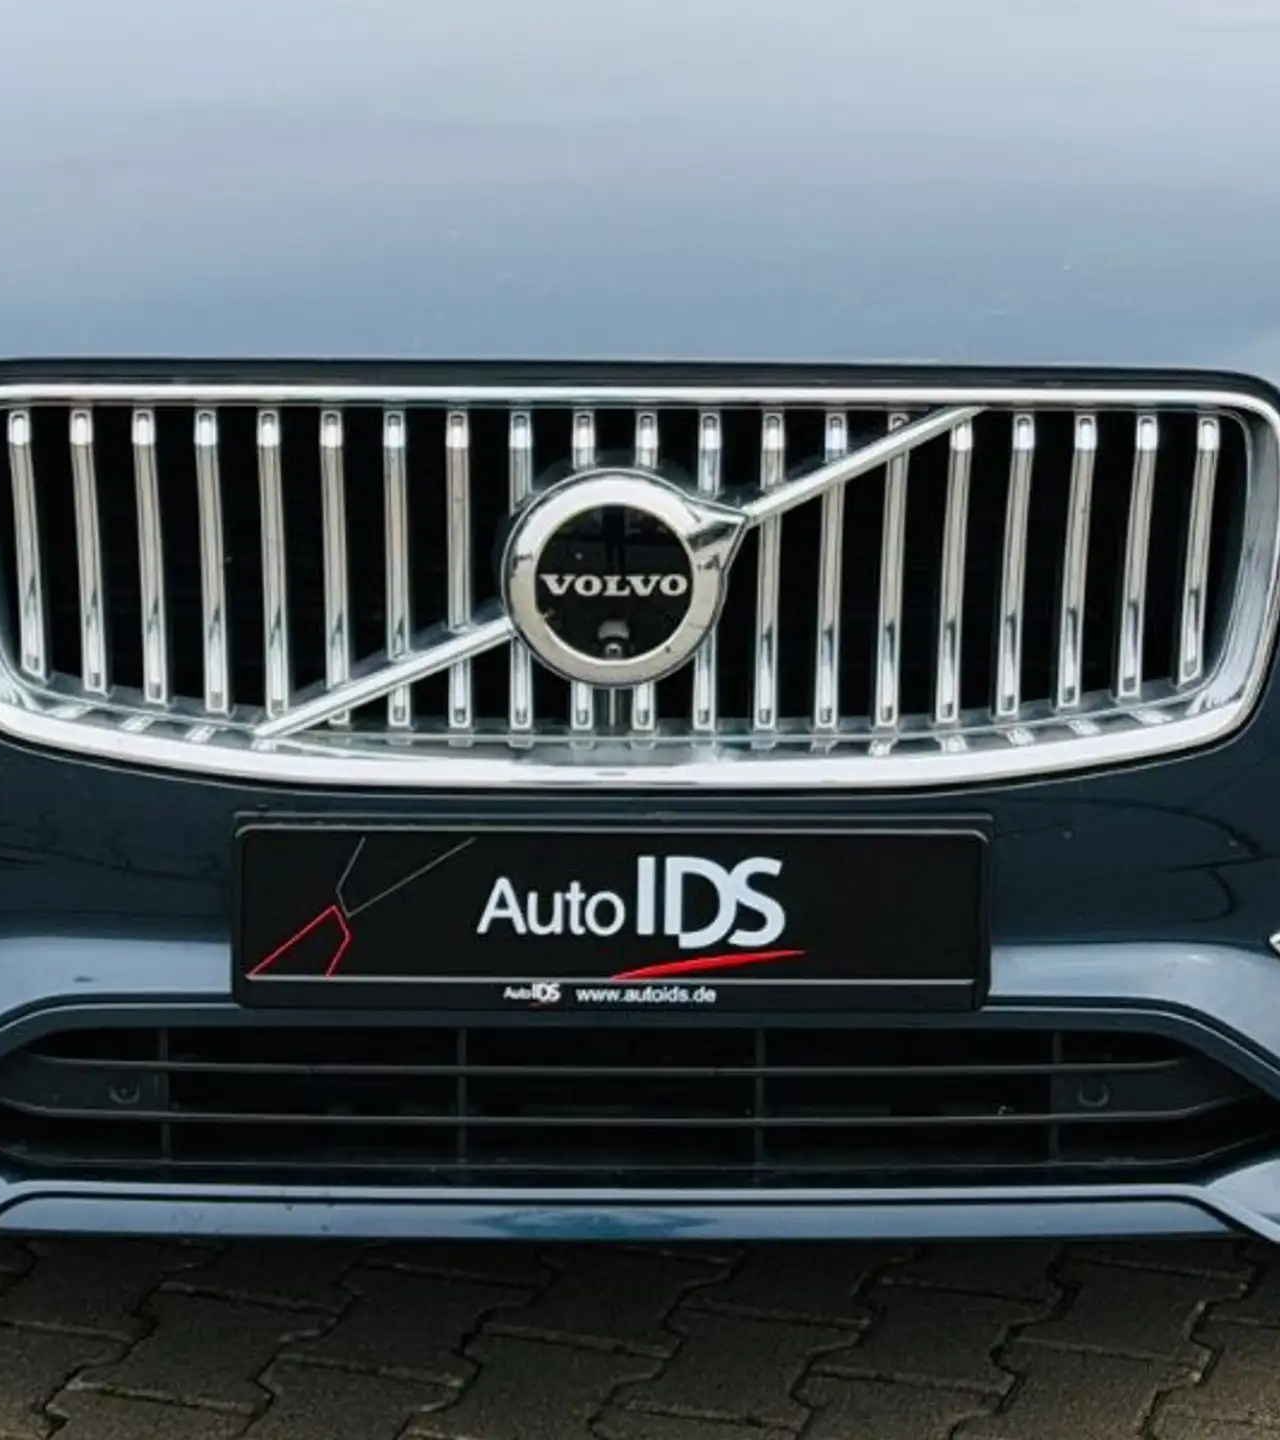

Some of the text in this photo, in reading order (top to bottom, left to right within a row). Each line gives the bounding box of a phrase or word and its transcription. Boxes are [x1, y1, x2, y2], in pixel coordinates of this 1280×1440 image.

[539, 573, 688, 597] VOLVO
[476, 855, 787, 949] Auto IDS
[575, 986, 717, 1003] www.autoids.de
